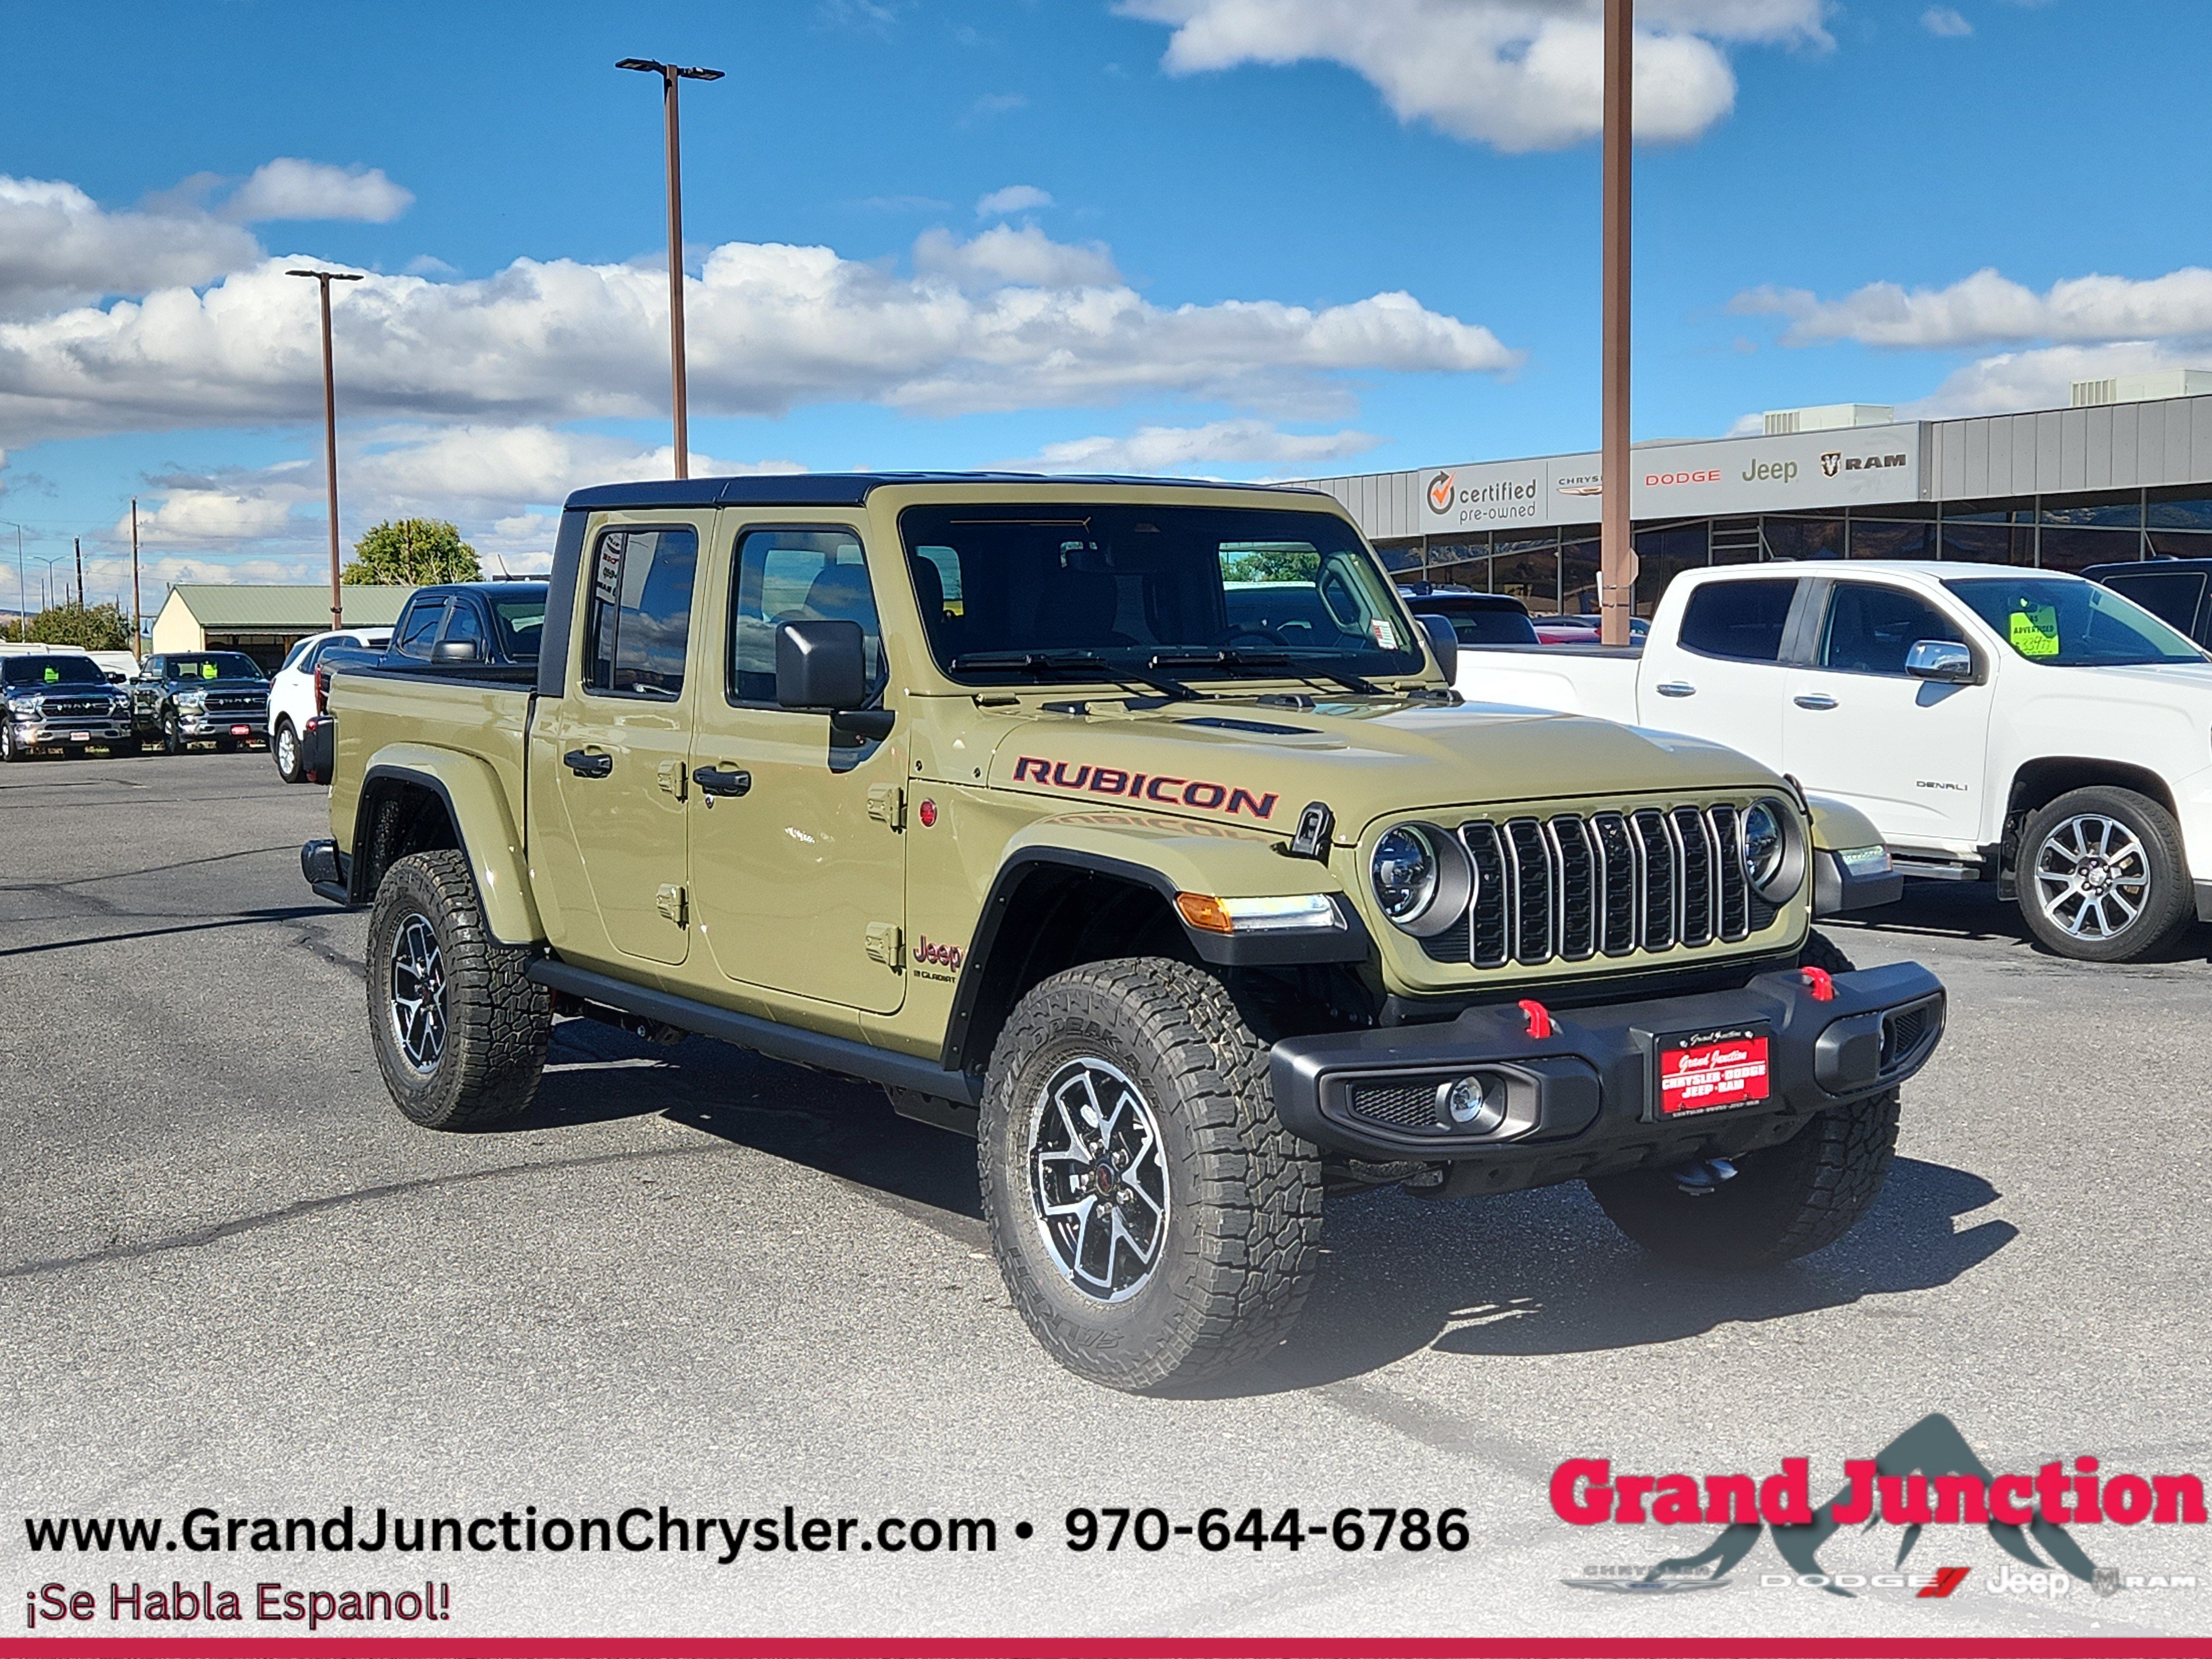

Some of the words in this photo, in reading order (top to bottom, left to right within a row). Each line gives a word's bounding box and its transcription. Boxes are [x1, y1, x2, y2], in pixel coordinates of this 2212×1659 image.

[1742, 459, 1798, 484] Jeep
[1846, 454, 1906, 471] RAM
[1558, 475, 1603, 485] CHRYS
[1645, 470, 1721, 486] DODGE
[1459, 479, 1536, 504] certified
[1459, 501, 1536, 525] pre-owned
[1013, 756, 1279, 820] RUBICON
[1916, 781, 1968, 791] DENALI
[913, 935, 963, 973] Jeep
[1679, 1052, 1711, 1073] Grand
[1710, 1050, 1747, 1069] Junction
[1682, 1084, 1714, 1098] JEEP
[1718, 1079, 1745, 1092] RAM
